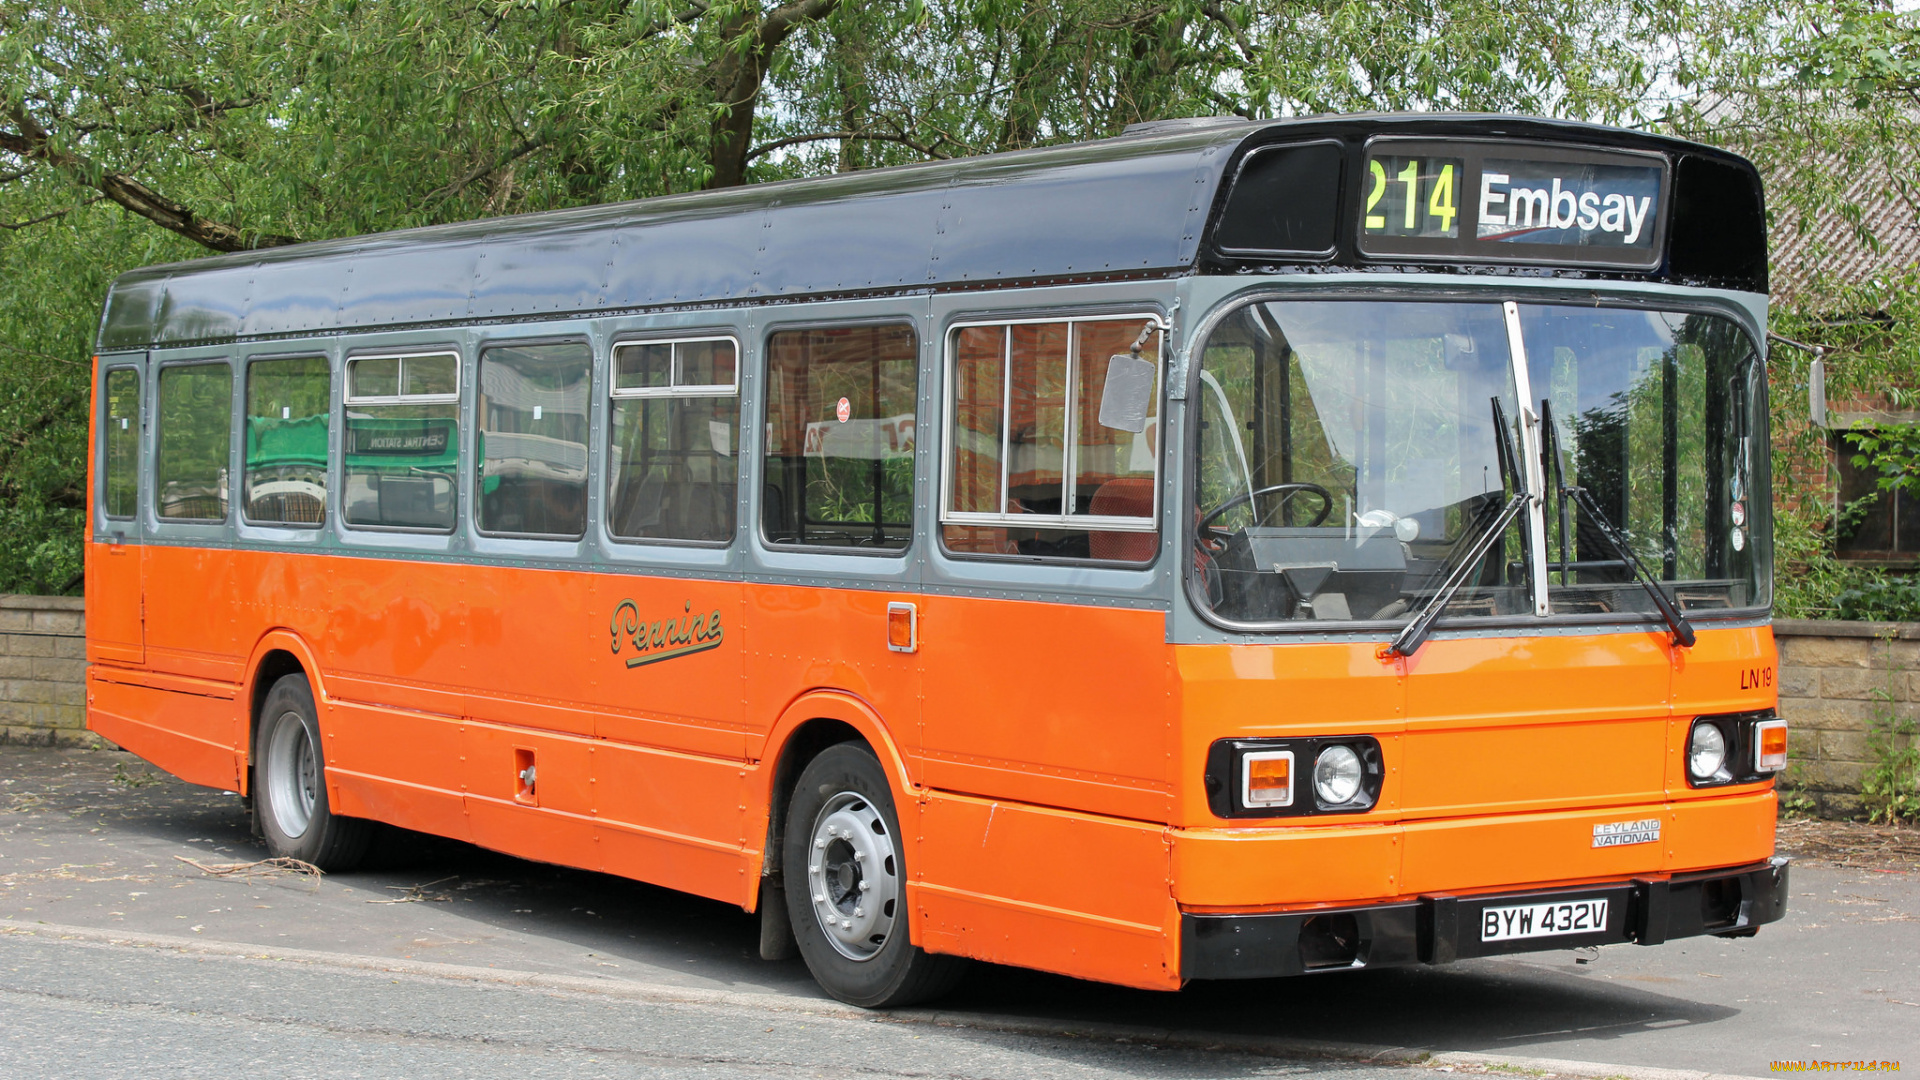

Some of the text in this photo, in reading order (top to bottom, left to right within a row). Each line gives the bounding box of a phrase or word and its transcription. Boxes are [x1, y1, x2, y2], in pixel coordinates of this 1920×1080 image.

[1365, 159, 1456, 232] 214
[1478, 173, 1651, 244] Embsay
[610, 598, 724, 660] Pennine
[1594, 832, 1659, 847] NATIONAL
[1595, 820, 1660, 835] LEYLAND
[1484, 902, 1606, 938] BYW 432V
